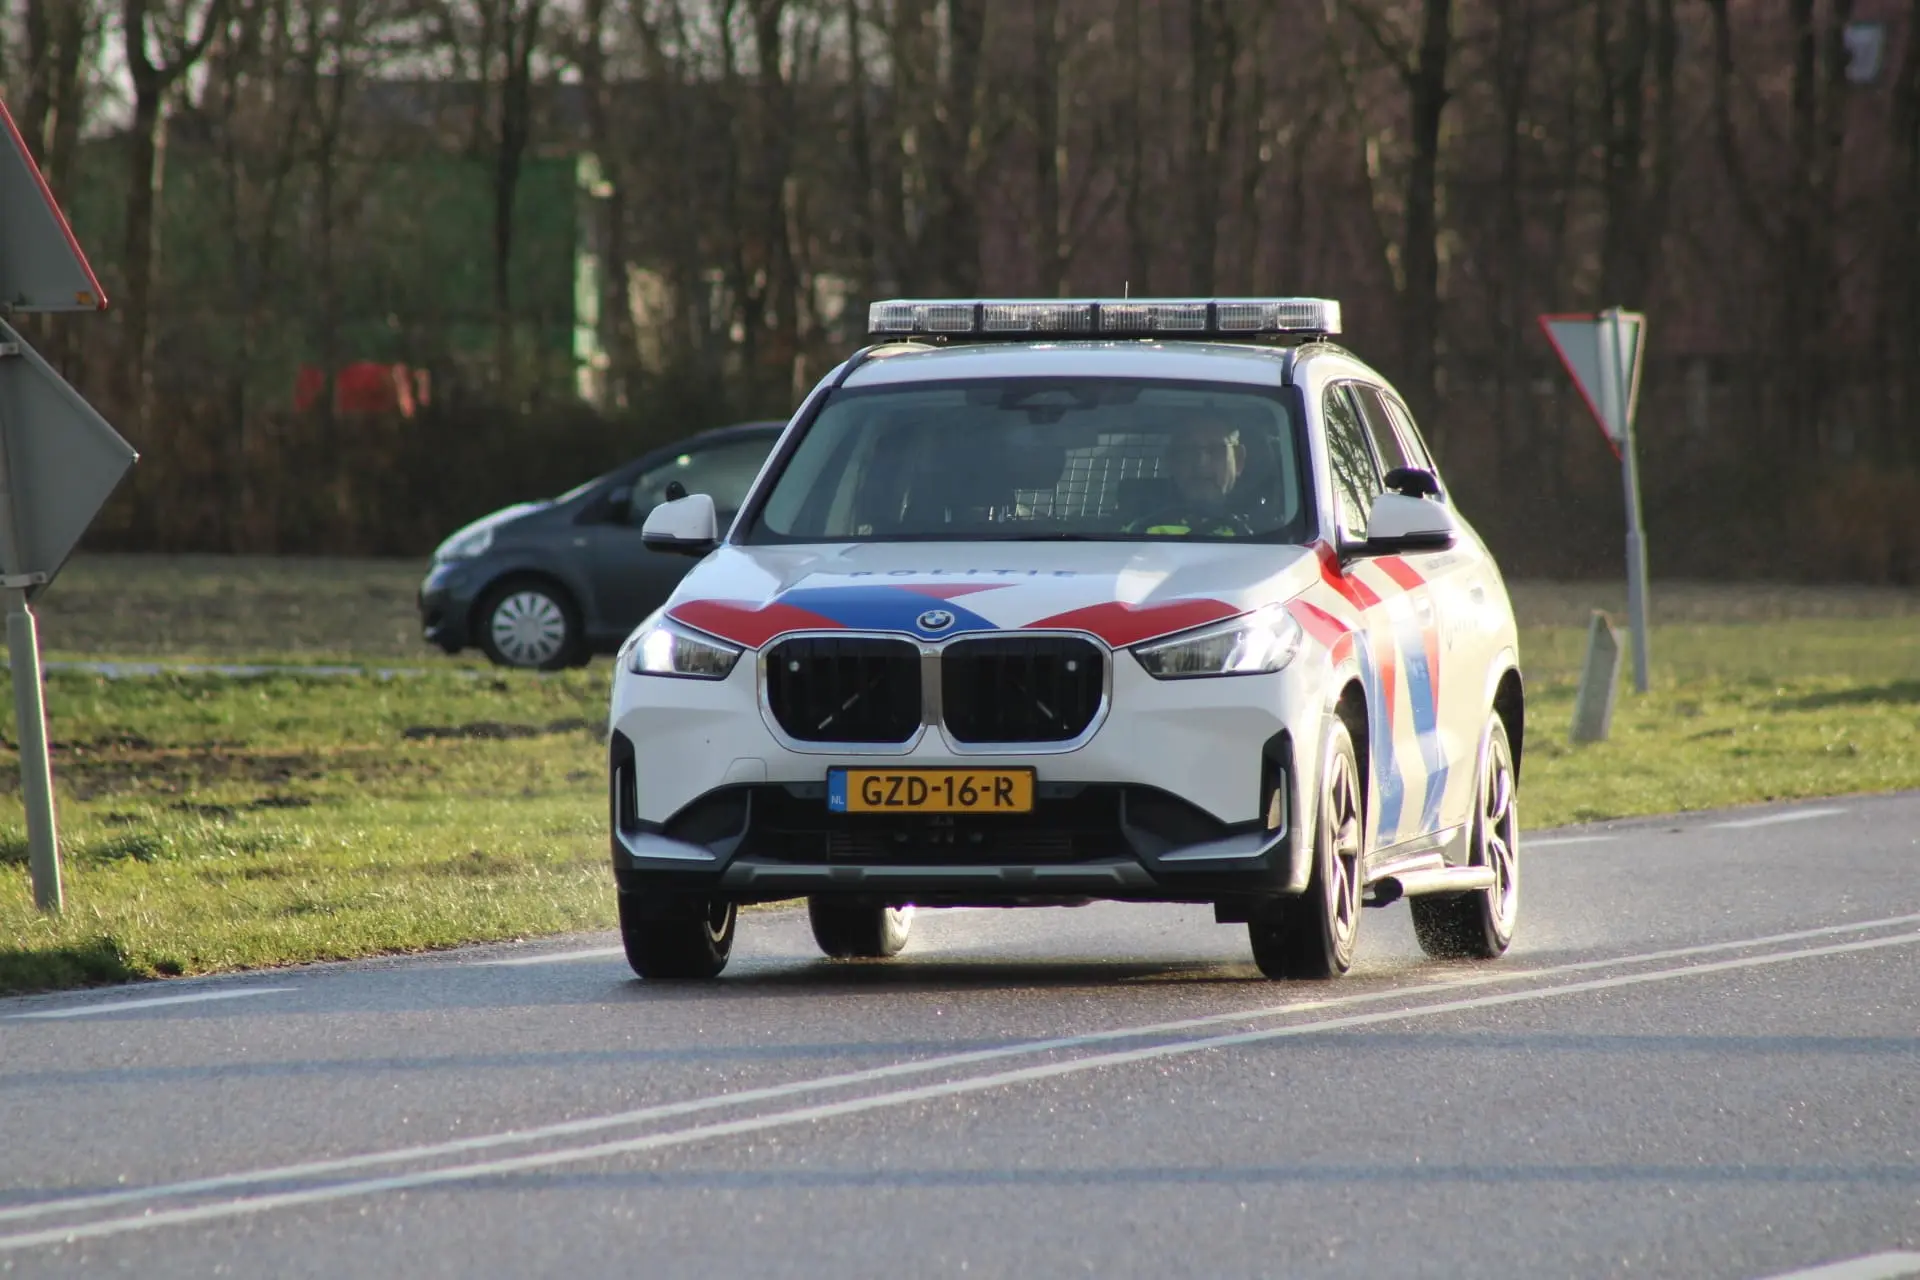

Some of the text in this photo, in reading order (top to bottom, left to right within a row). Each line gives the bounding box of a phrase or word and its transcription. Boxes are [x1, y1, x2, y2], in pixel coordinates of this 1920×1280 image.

[849, 568, 1078, 578] POLITIE
[861, 775, 1015, 807] GZD-16-R
[831, 795, 845, 805] NL
